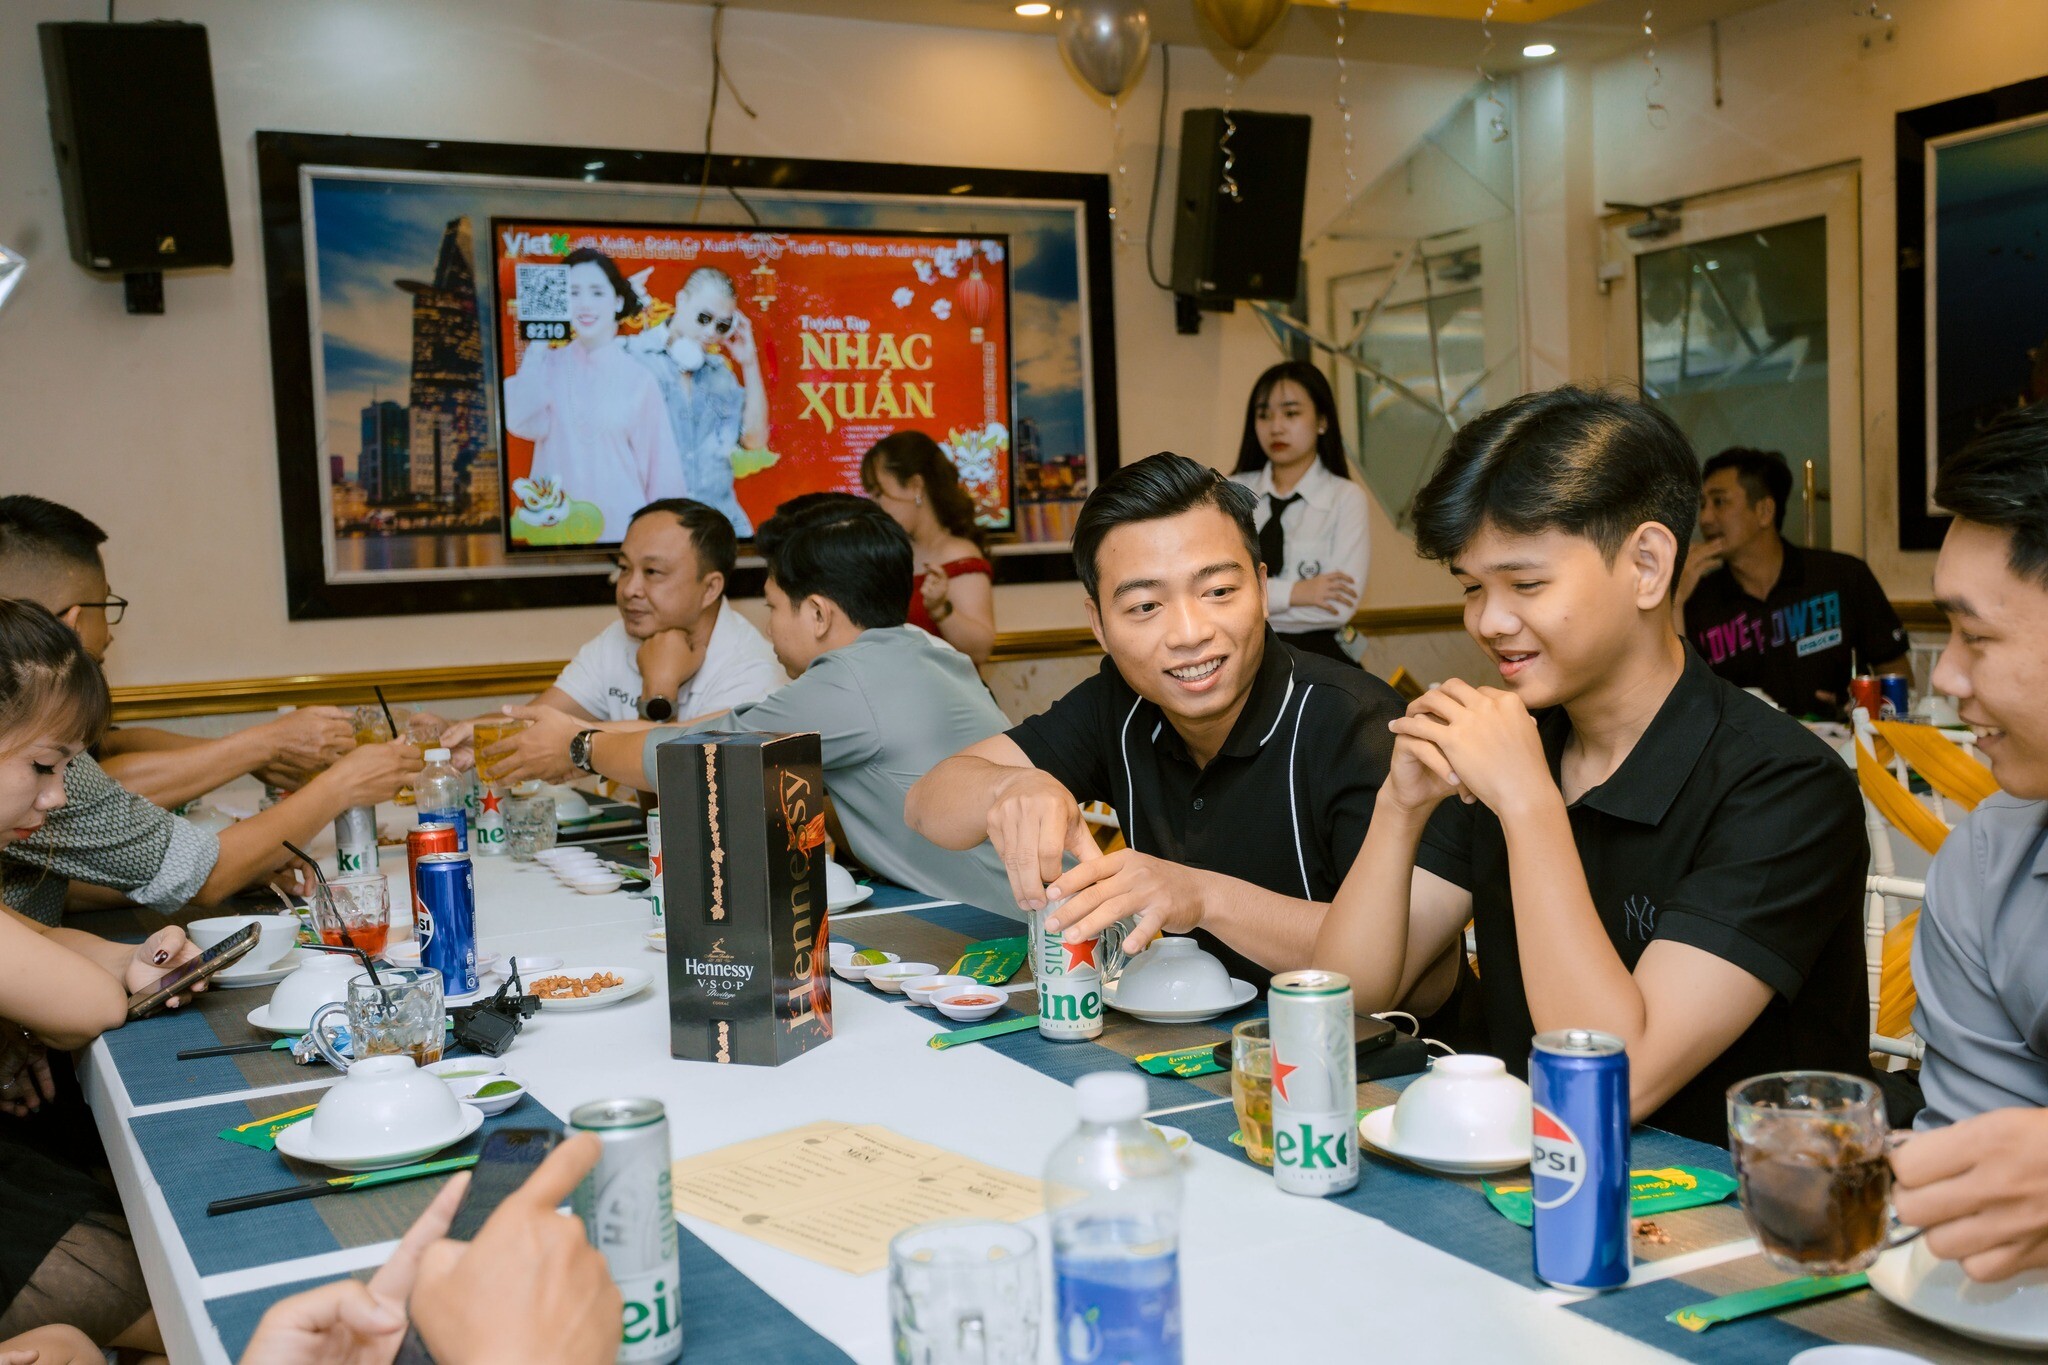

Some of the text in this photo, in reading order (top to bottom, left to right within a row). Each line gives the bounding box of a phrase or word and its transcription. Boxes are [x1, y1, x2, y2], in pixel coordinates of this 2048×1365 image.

[526, 322, 565, 339] 8210
[796, 375, 936, 434] XUÂN
[785, 769, 816, 1031] Hennessy
[685, 958, 754, 981] Hennessy
[1044, 929, 1063, 976] SILVE
[1039, 982, 1102, 1021] ine
